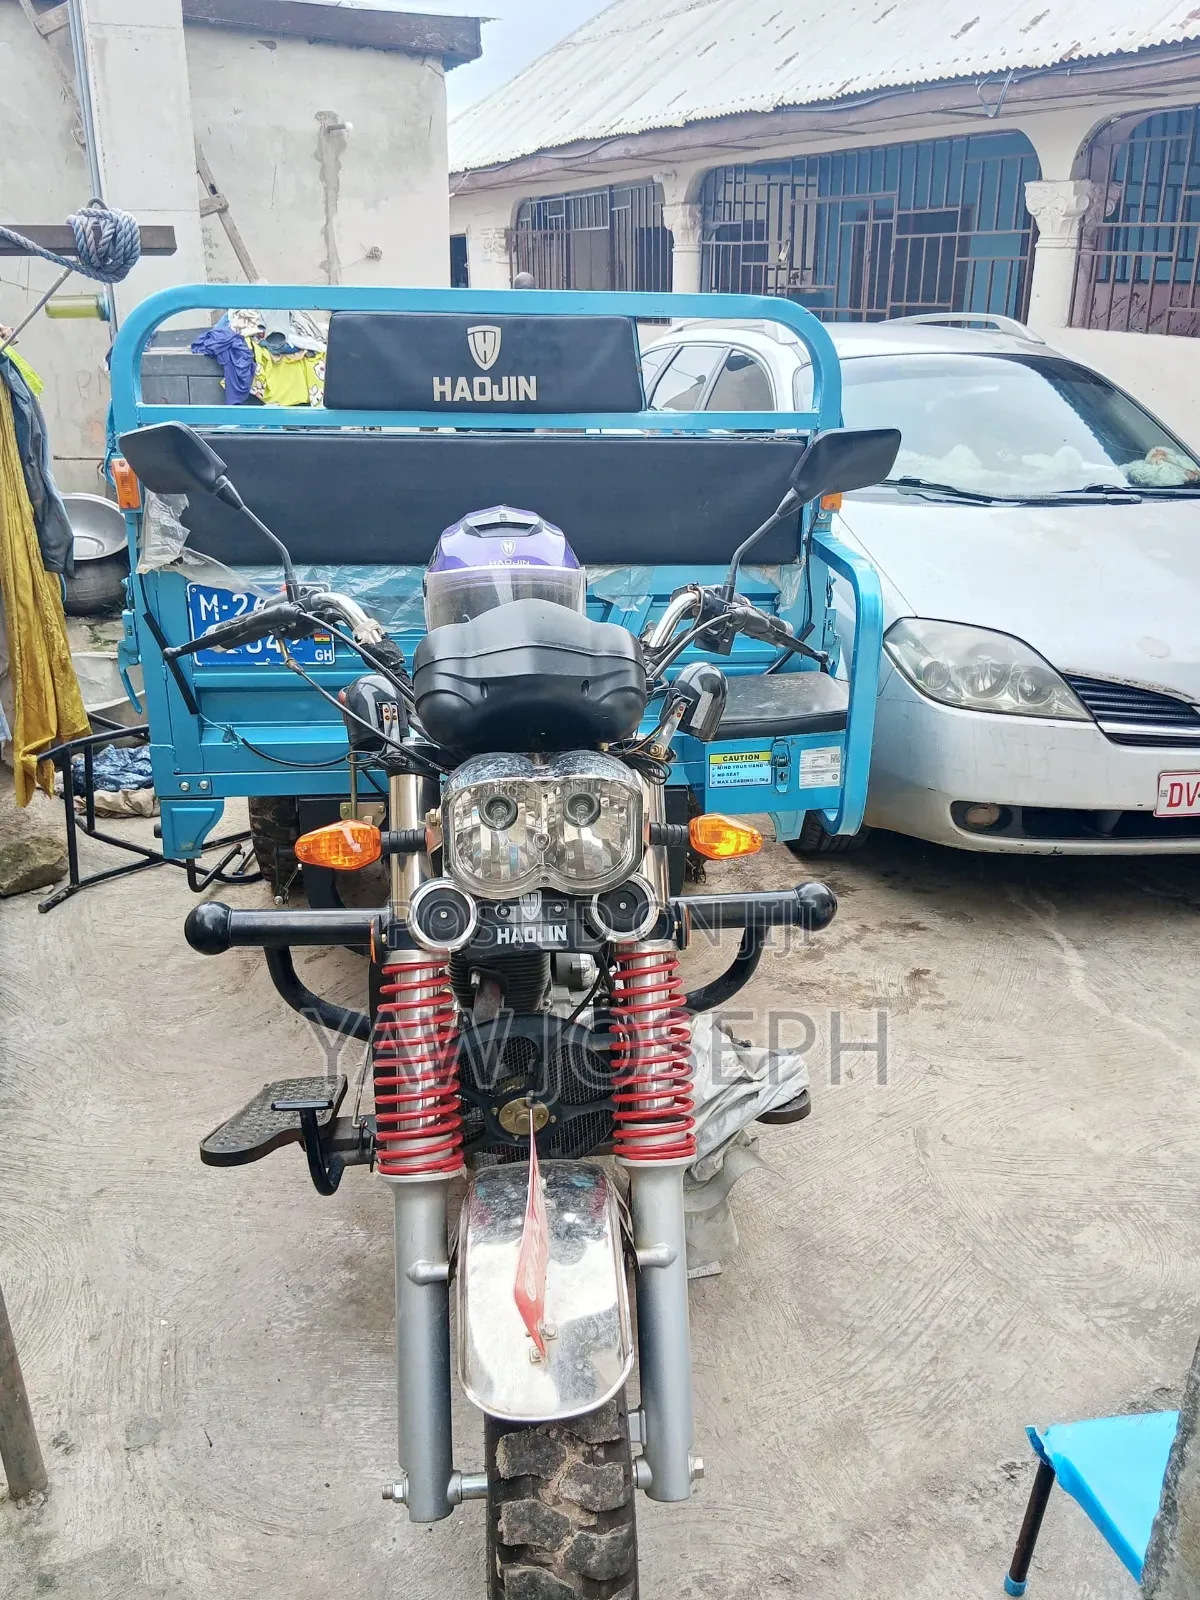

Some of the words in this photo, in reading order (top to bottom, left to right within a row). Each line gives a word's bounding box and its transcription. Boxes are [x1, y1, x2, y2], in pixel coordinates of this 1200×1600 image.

[433, 375, 537, 402] HAOJIN
[315, 649, 333, 661] GH
[722, 754, 760, 762] CAUTION
[497, 924, 567, 945] HAOJIN
